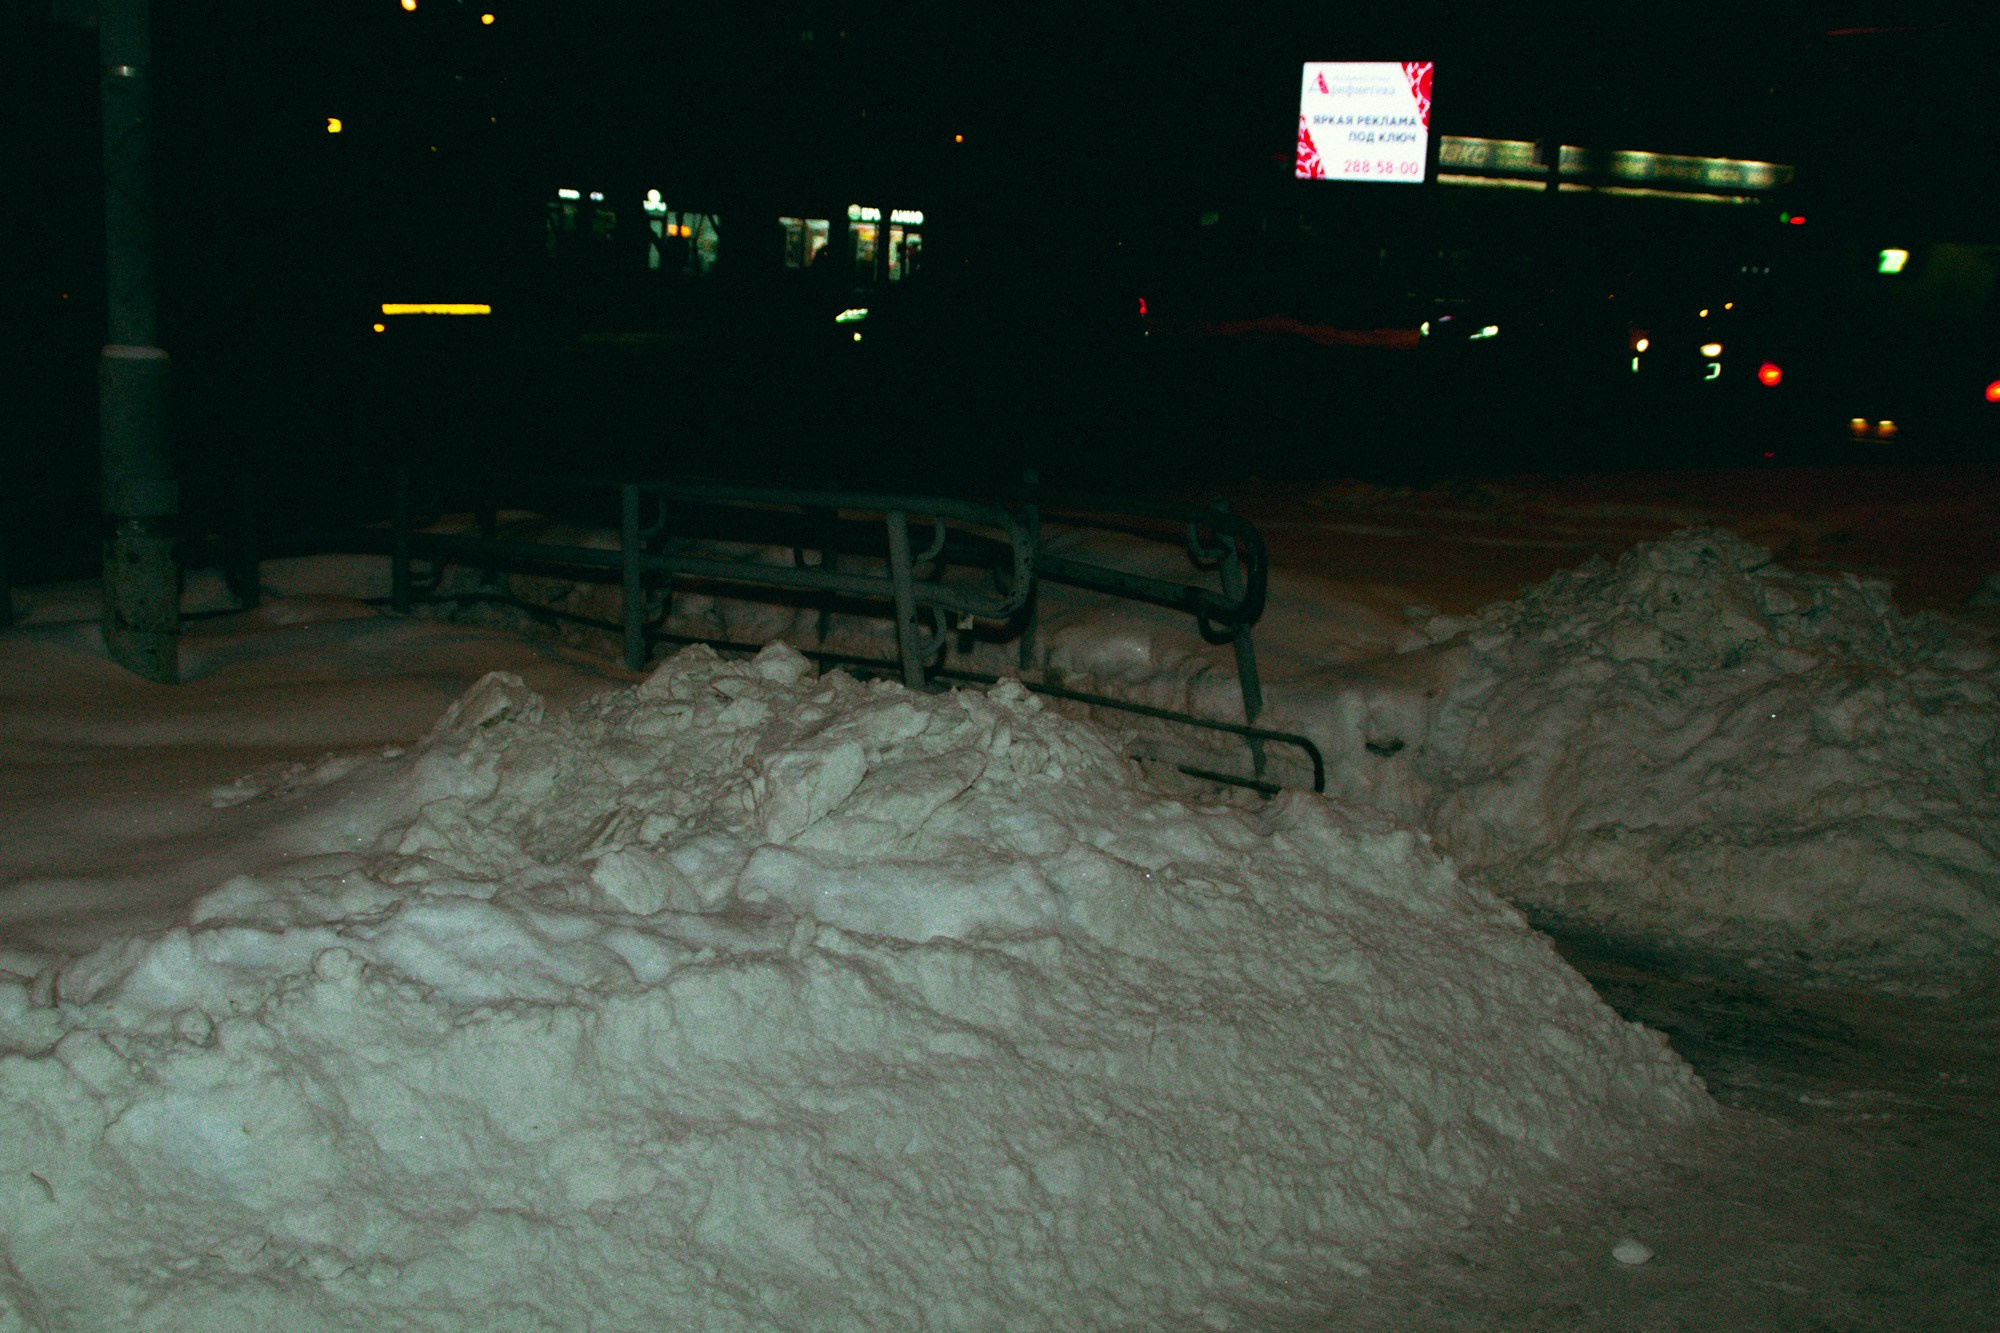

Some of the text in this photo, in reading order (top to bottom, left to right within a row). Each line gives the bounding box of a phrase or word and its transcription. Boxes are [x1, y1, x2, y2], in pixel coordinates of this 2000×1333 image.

[1313, 115, 1417, 126] ЯРКАЯ РЕКЛАМА
[1349, 131, 1416, 143] ПОД КЛЮЧ
